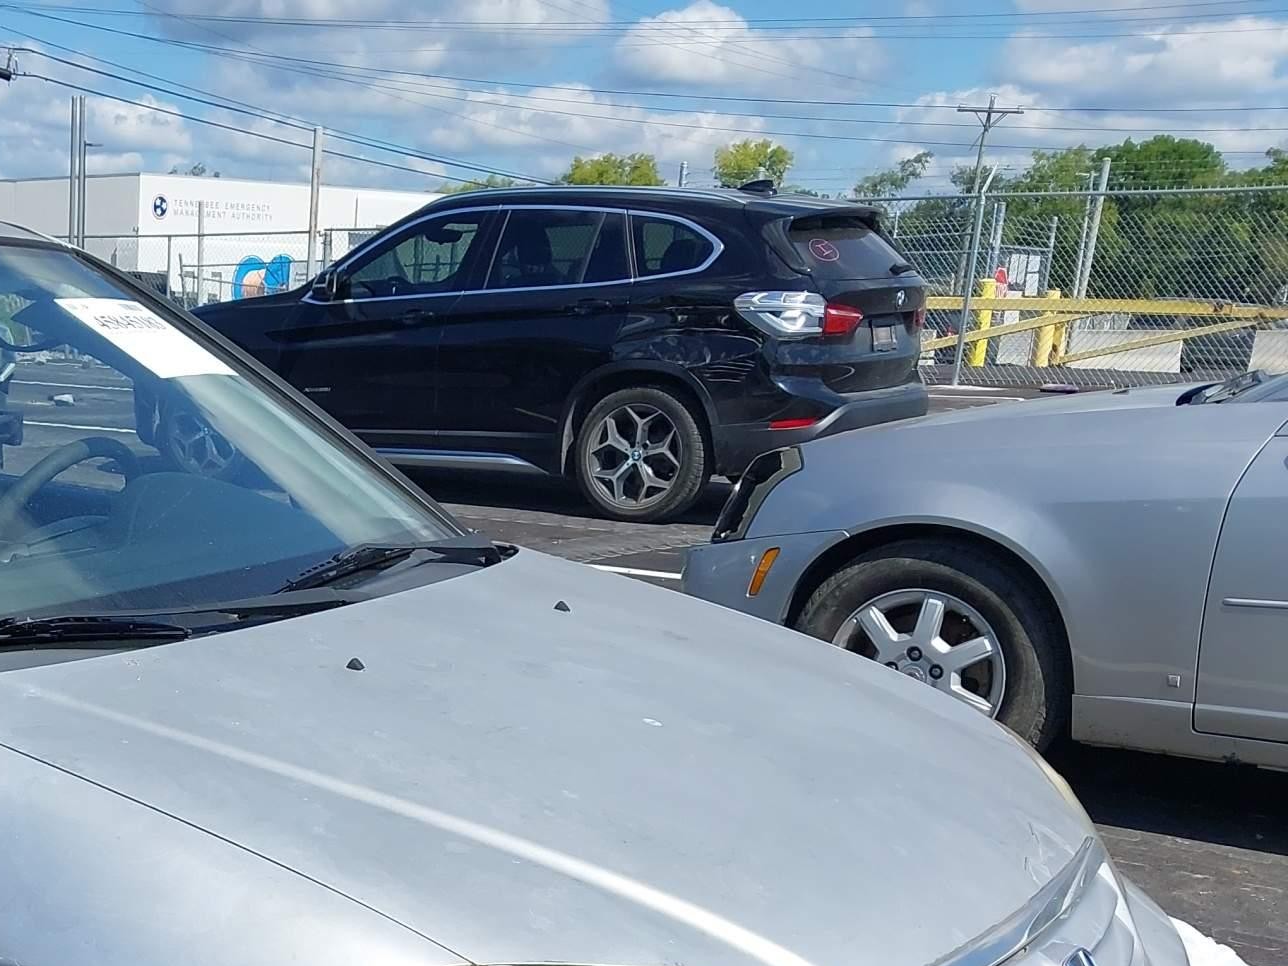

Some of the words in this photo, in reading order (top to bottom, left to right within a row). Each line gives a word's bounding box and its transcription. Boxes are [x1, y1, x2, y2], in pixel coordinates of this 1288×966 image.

[173, 199, 220, 210] TENNESEE
[173, 208, 227, 219] MANAGMENT
[231, 211, 273, 222] AUTHORITY
